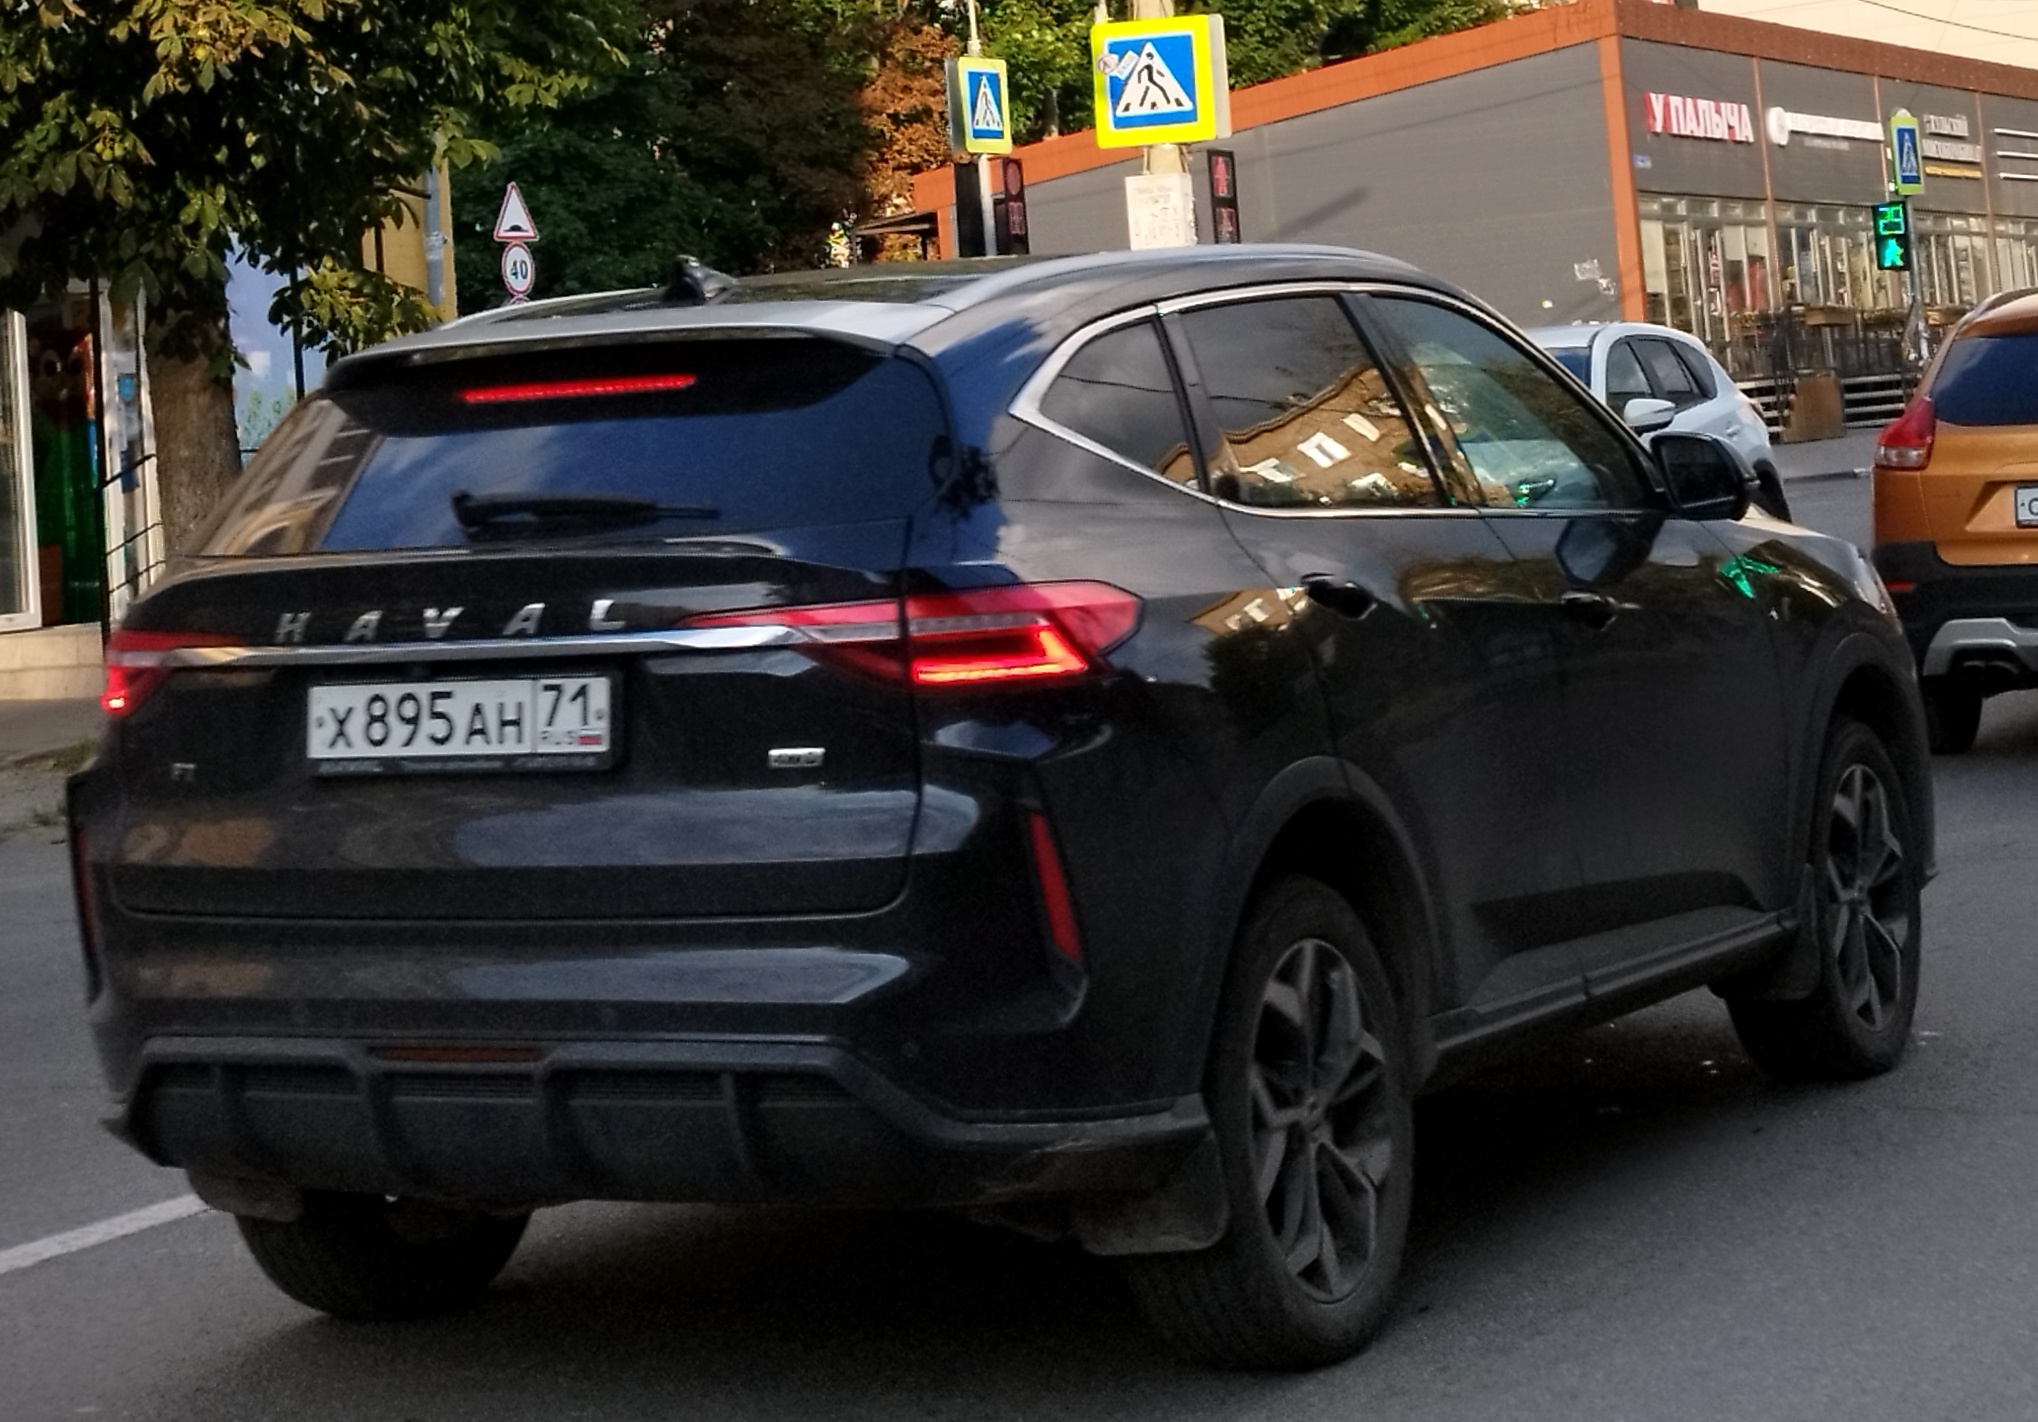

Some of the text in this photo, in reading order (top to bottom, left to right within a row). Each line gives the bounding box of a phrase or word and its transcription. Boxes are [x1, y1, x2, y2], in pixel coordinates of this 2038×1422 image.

[1647, 92, 1668, 133] У
[1668, 95, 1754, 142] ПАЛЫЧА
[511, 260, 528, 280] 40
[274, 599, 626, 643] HAVAL
[328, 683, 590, 749] Х895АН 71
